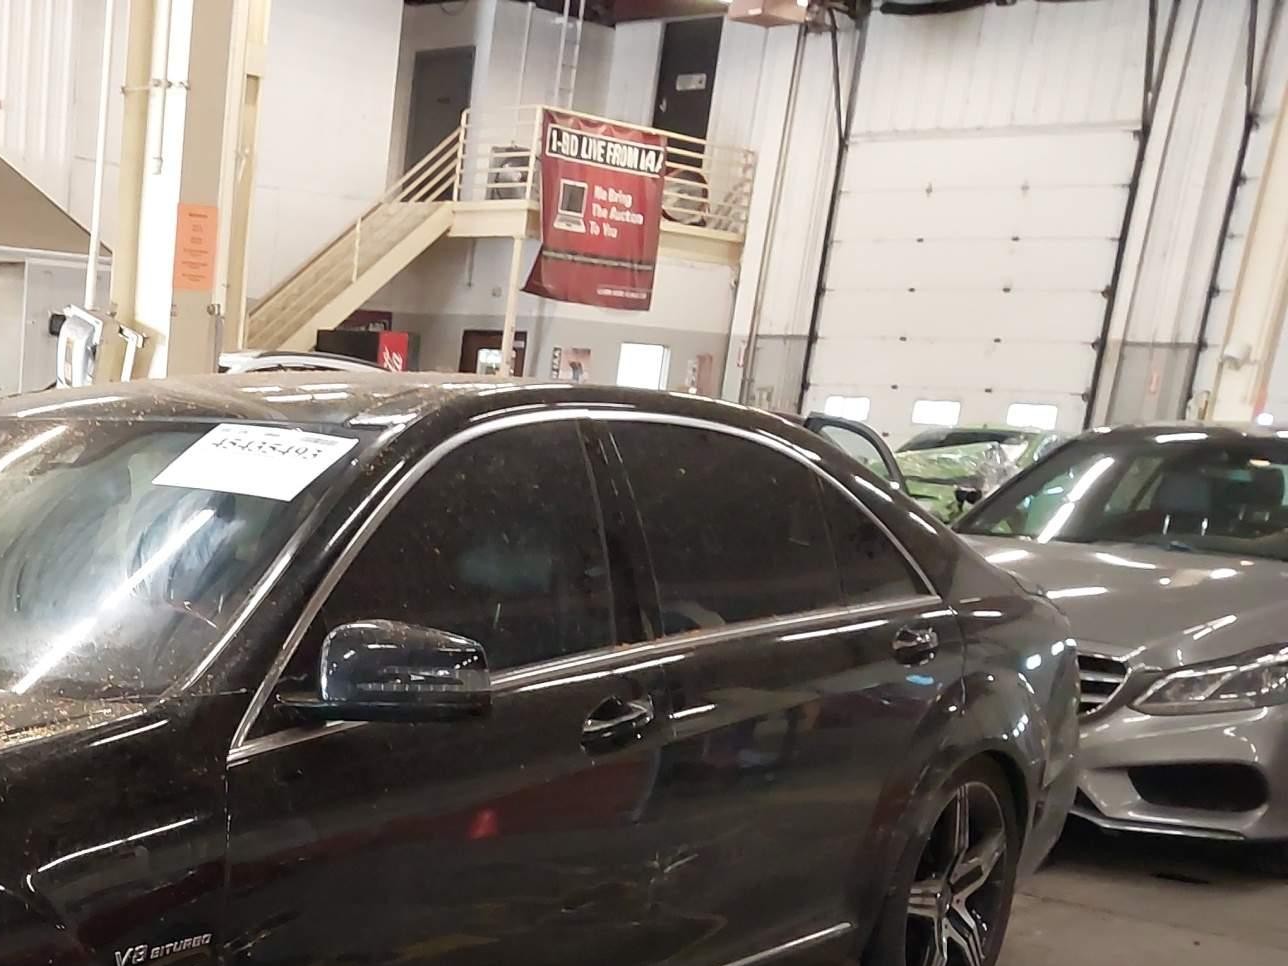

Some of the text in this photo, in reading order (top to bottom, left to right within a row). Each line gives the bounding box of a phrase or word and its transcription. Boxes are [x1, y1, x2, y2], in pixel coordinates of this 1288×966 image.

[608, 187, 633, 208] Bring
[592, 202, 644, 225] The Auction
[589, 220, 618, 238] To You
[150, 933, 213, 960] BITURBO
